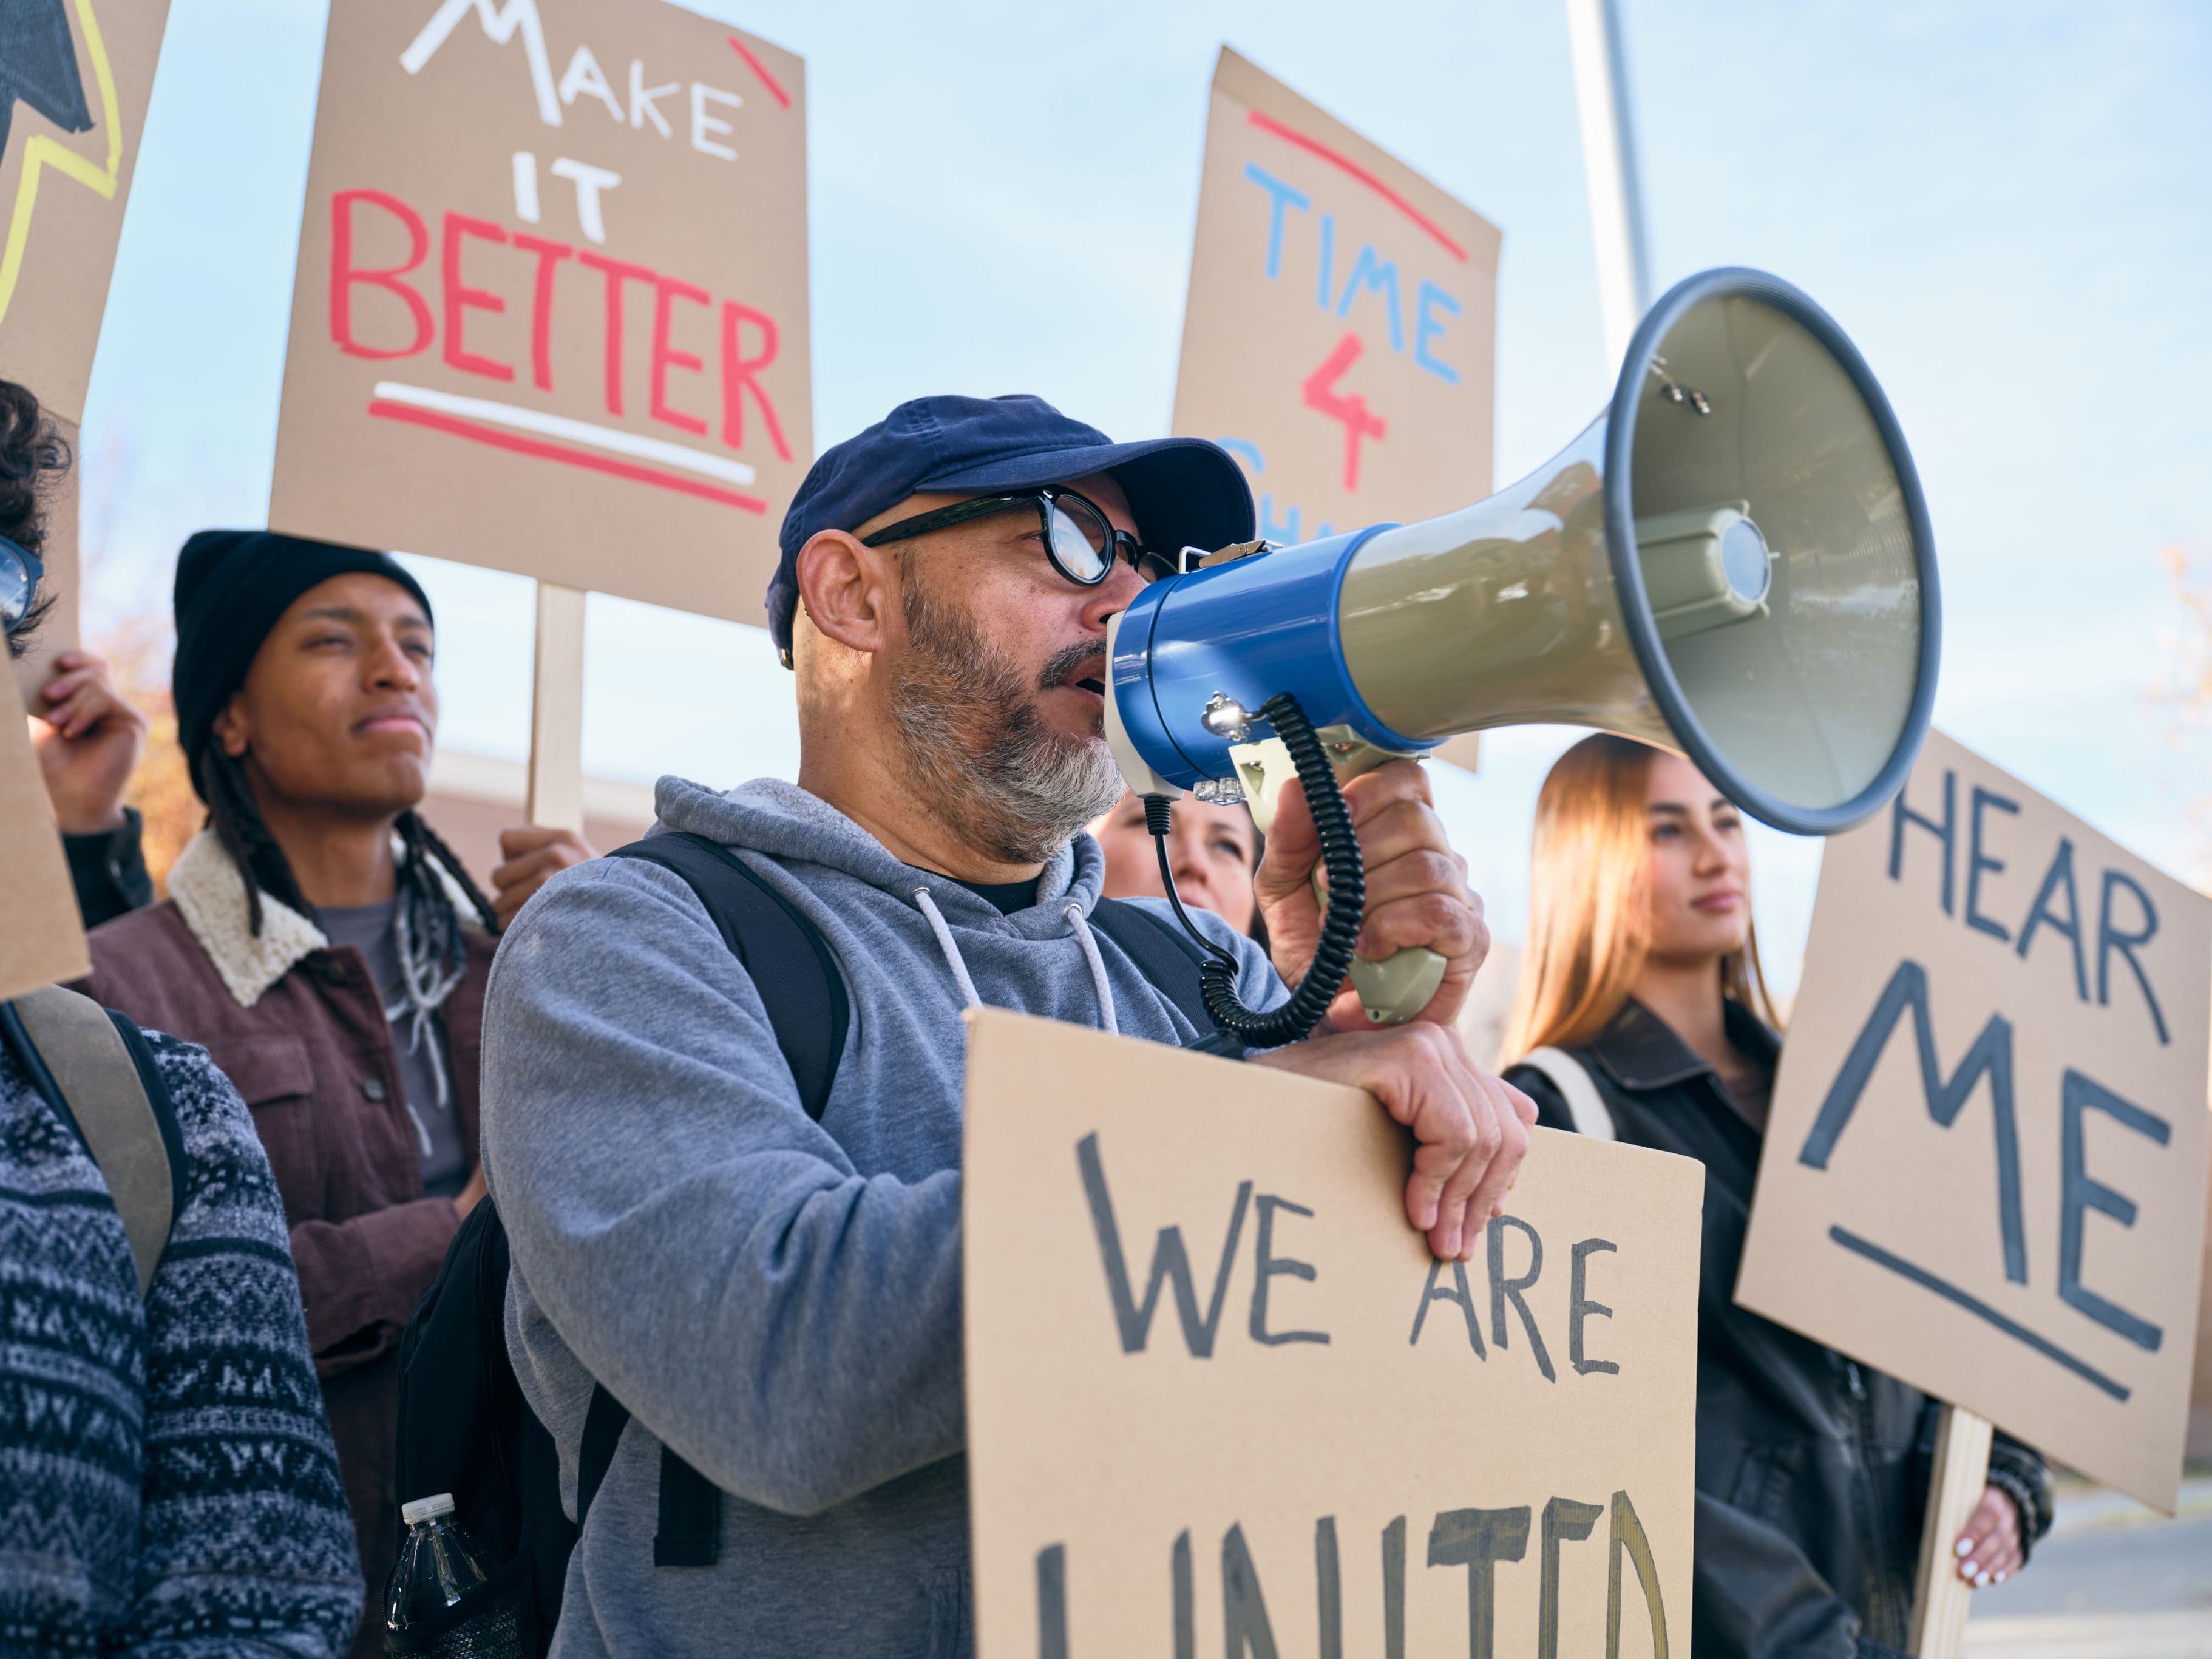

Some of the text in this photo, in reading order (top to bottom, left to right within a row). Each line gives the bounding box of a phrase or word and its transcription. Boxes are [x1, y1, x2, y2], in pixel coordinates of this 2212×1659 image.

[399, 0, 743, 161] MAKE
[512, 152, 622, 244] IT
[330, 188, 793, 463] BETTER
[1244, 160, 1464, 385] TIME
[1301, 331, 1388, 494] 4
[1889, 770, 2170, 1046] HEAR
[1076, 1130, 1620, 1384] WE ARE
[1797, 958, 2172, 1353] ME
